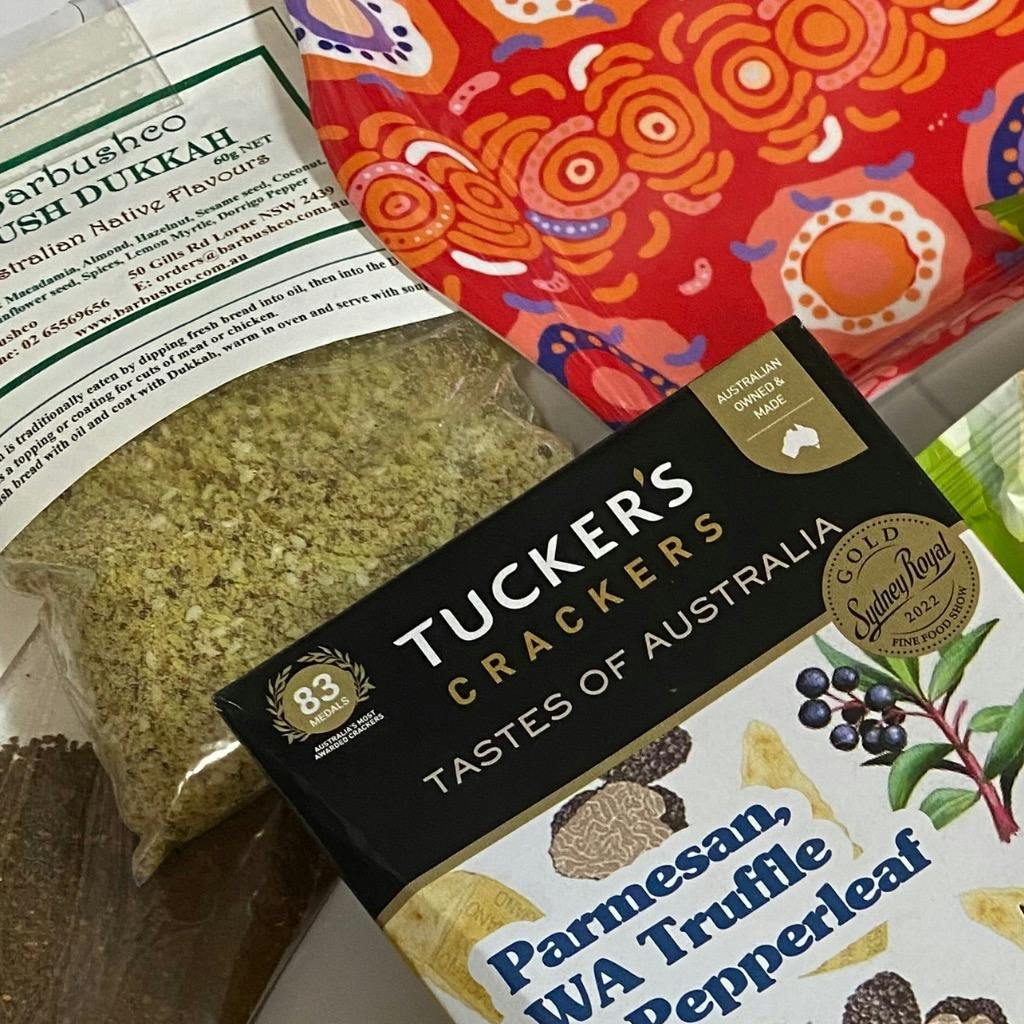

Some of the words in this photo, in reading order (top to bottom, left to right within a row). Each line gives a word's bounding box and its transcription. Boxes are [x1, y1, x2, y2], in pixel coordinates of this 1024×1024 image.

[71, 127, 239, 208] DUKKAH
[213, 149, 240, 165] 60g
[241, 133, 273, 154] NET
[51, 278, 81, 297] seed,
[81, 259, 124, 281] Spices,
[126, 239, 169, 261] Lemon
[172, 216, 217, 242] Myrtle,
[217, 197, 264, 222] Dorrigo
[265, 177, 309, 200] Pepper
[89, 199, 165, 237] Native
[166, 153, 271, 204] Flavours
[128, 266, 146, 280] 50
[150, 249, 185, 269] Gills
[187, 238, 211, 254] Rd
[213, 219, 257, 242] Lorne
[258, 199, 297, 222] NSW
[300, 185, 335, 206] 2439
[5, 265, 81, 304] Macadamia,
[82, 241, 134, 268] Almond,
[134, 217, 195, 244] Hazelnut,
[195, 195, 240, 218] Sesame
[242, 179, 272, 197] seed,
[21, 334, 40, 350] 02
[42, 298, 111, 338] 65569656
[134, 280, 153, 293] E:
[156, 199, 349, 284] orders@barbushco.com.au
[75, 253, 249, 338] www.barbushco.com.au
[6, 466, 14, 475] a
[14, 430, 58, 468] topping
[56, 419, 70, 433] or
[71, 391, 116, 423] coating
[114, 380, 134, 394] for
[135, 366, 161, 383] cuts
[163, 355, 178, 369] of
[178, 340, 209, 361] meat
[210, 332, 226, 344] or
[227, 311, 279, 336] chicken.
[12, 459, 44, 488] bread
[44, 439, 70, 461] with
[71, 427, 87, 442] oil
[88, 410, 110, 430] and
[111, 394, 137, 414] coat
[137, 377, 166, 397] with
[167, 351, 222, 381] Dukkah,
[222, 331, 260, 353] warm
[262, 325, 276, 336] in
[277, 313, 308, 330] oven
[309, 303, 334, 318] and
[336, 294, 370, 310] serve
[371, 288, 400, 302] with
[15, 392, 84, 445] traditionally
[86, 373, 120, 395] eaten
[119, 362, 136, 377] by
[138, 337, 188, 367] dipping
[187, 321, 219, 341] fresh
[220, 302, 258, 324] bread
[259, 293, 285, 308] into
[287, 284, 308, 298] oil,
[308, 273, 338, 290] then
[338, 264, 364, 278] into
[365, 260, 387, 272] the
[717, 357, 783, 405] AUSTRALIAN
[734, 380, 775, 413] OWNED
[775, 376, 785, 388] &
[753, 394, 788, 420] MADE
[393, 461, 695, 667] TUCKER'S
[836, 526, 899, 584] GOLD
[847, 574, 910, 643] Sydney
[894, 530, 952, 588] Royal
[447, 512, 724, 706] CRACKERS
[892, 637, 920, 647] FINE
[922, 619, 951, 642] FOOD
[950, 585, 968, 620] SHOW
[904, 594, 940, 623] 2022
[293, 672, 340, 715] 83
[423, 692, 574, 795] TASTES
[579, 648, 627, 696] OF
[643, 516, 844, 660] AUSTRALIA
[309, 696, 350, 728] MEDALS
[314, 722, 358, 753] AUSTRALIA'S
[358, 709, 377, 726] MOST
[314, 736, 349, 760] AWARDED
[349, 712, 385, 740] CRACKERS
[487, 803, 792, 996] Parmesan,
[637, 836, 833, 966] Truffle
